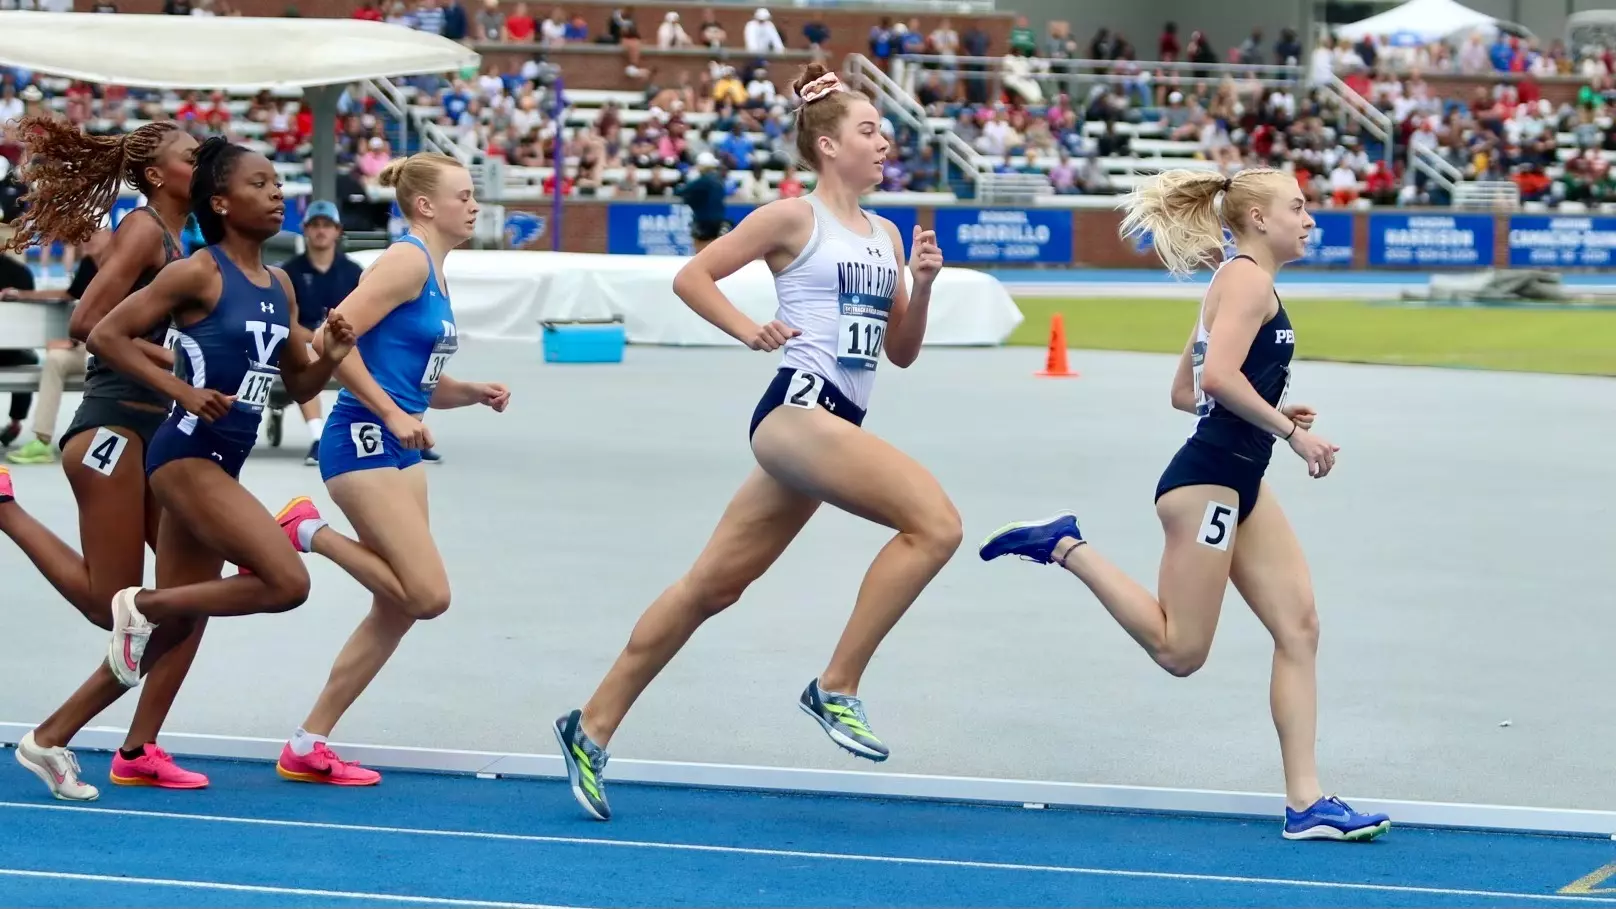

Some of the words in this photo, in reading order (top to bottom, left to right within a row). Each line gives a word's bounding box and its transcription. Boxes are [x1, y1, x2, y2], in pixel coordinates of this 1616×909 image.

[837, 262, 872, 295] NORTH
[847, 322, 885, 357] 112
[242, 375, 273, 402] 175
[790, 372, 816, 407] 2
[91, 435, 119, 470] 4
[358, 424, 378, 454] 6
[1204, 505, 1231, 545] 5
